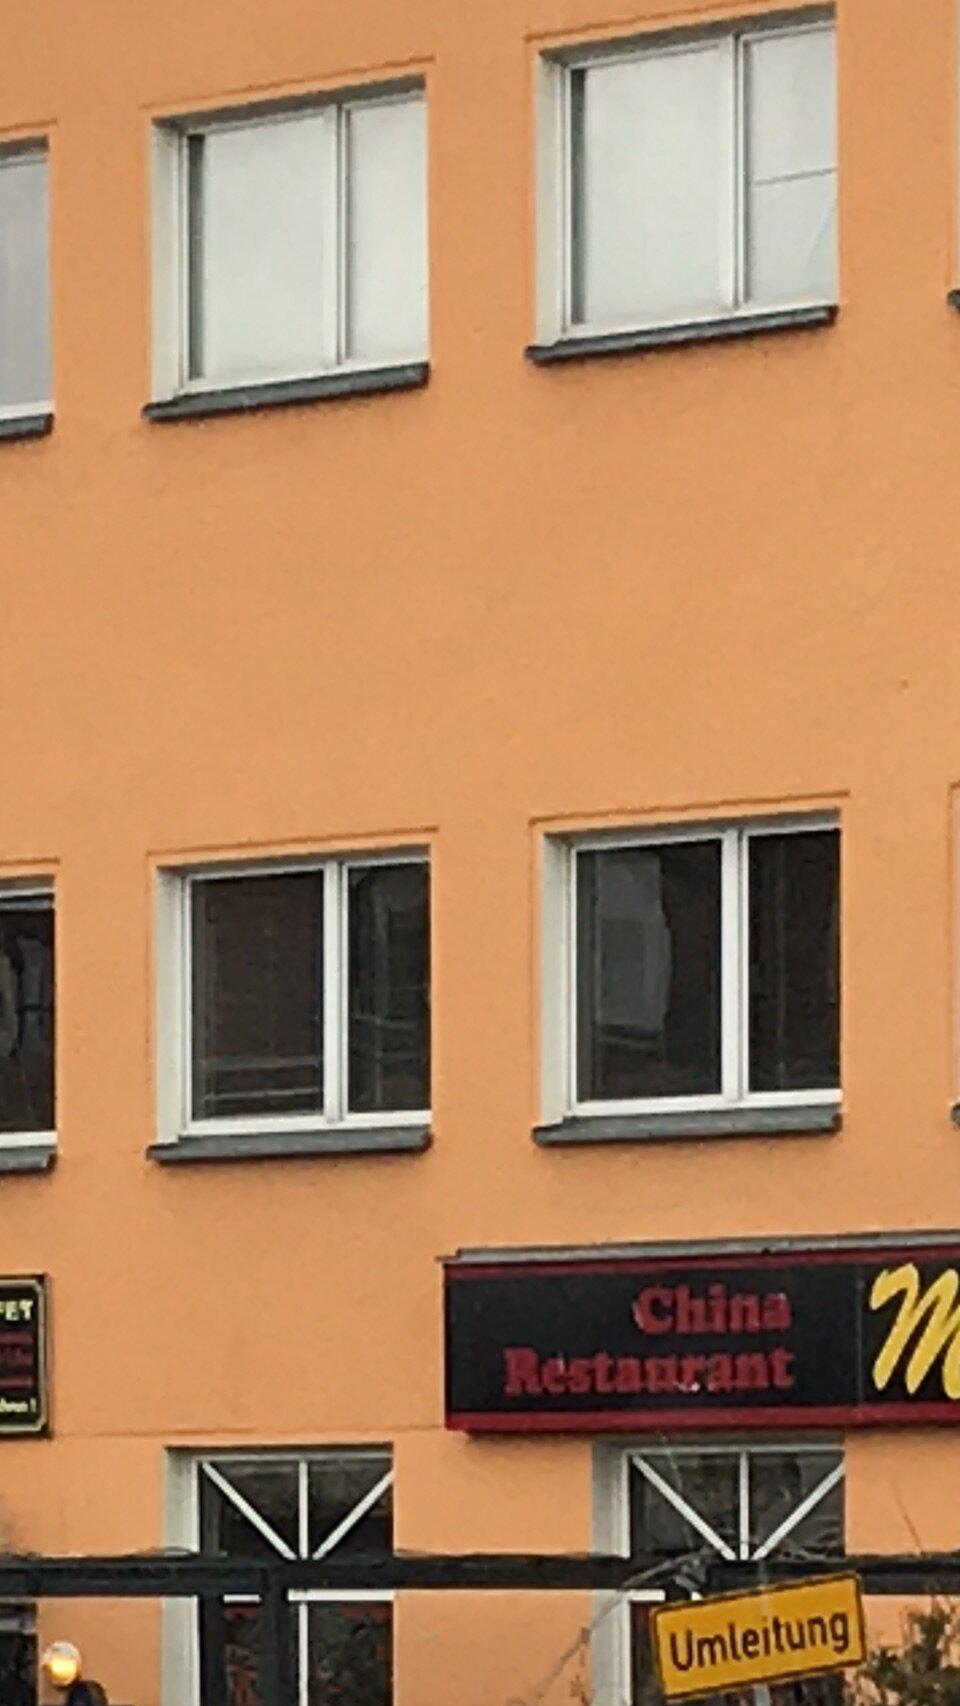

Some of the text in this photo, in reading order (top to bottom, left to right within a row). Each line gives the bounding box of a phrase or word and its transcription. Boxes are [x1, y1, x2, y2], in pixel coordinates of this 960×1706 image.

[634, 1284, 792, 1335] China
[503, 1345, 795, 1395] Restaurant
[670, 1612, 849, 1672] Umleitung
